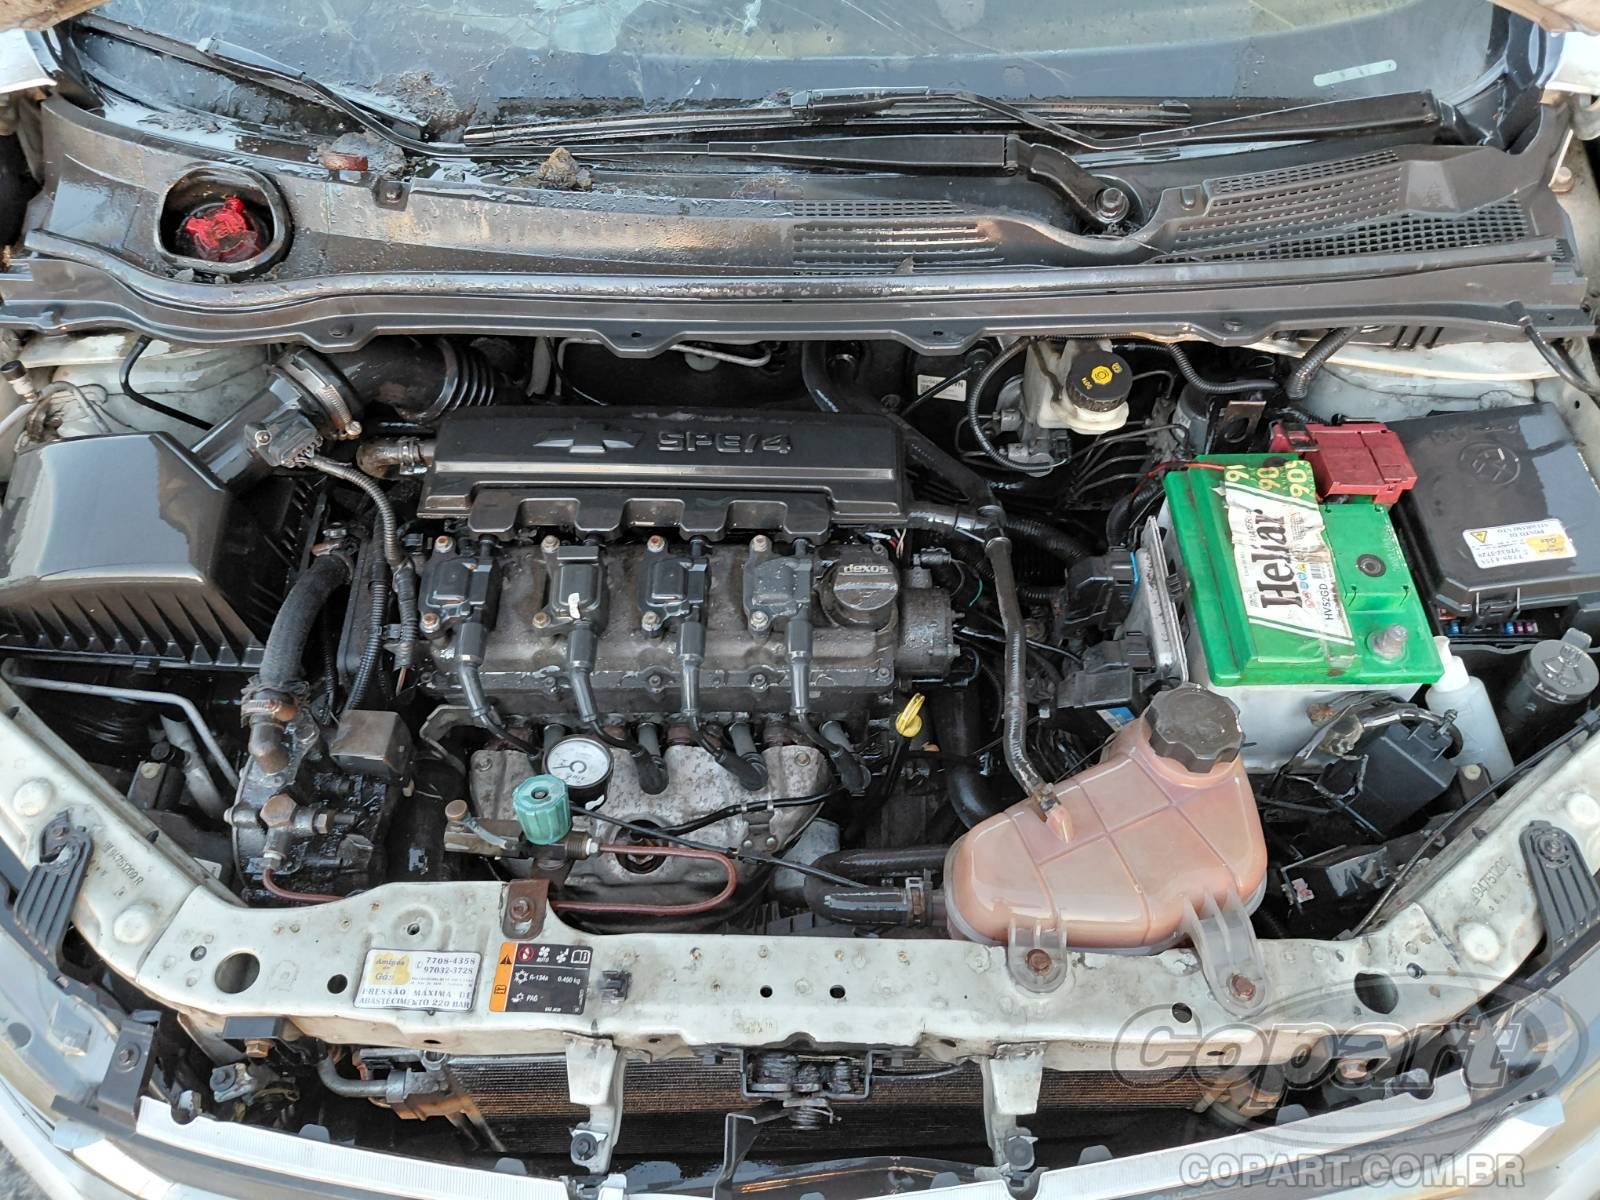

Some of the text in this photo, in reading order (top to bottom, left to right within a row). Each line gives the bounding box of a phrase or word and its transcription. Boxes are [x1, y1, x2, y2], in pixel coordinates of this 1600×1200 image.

[657, 431, 793, 454] SPE/4
[843, 563, 889, 573] dexos
[1251, 509, 1303, 609] Heliar
